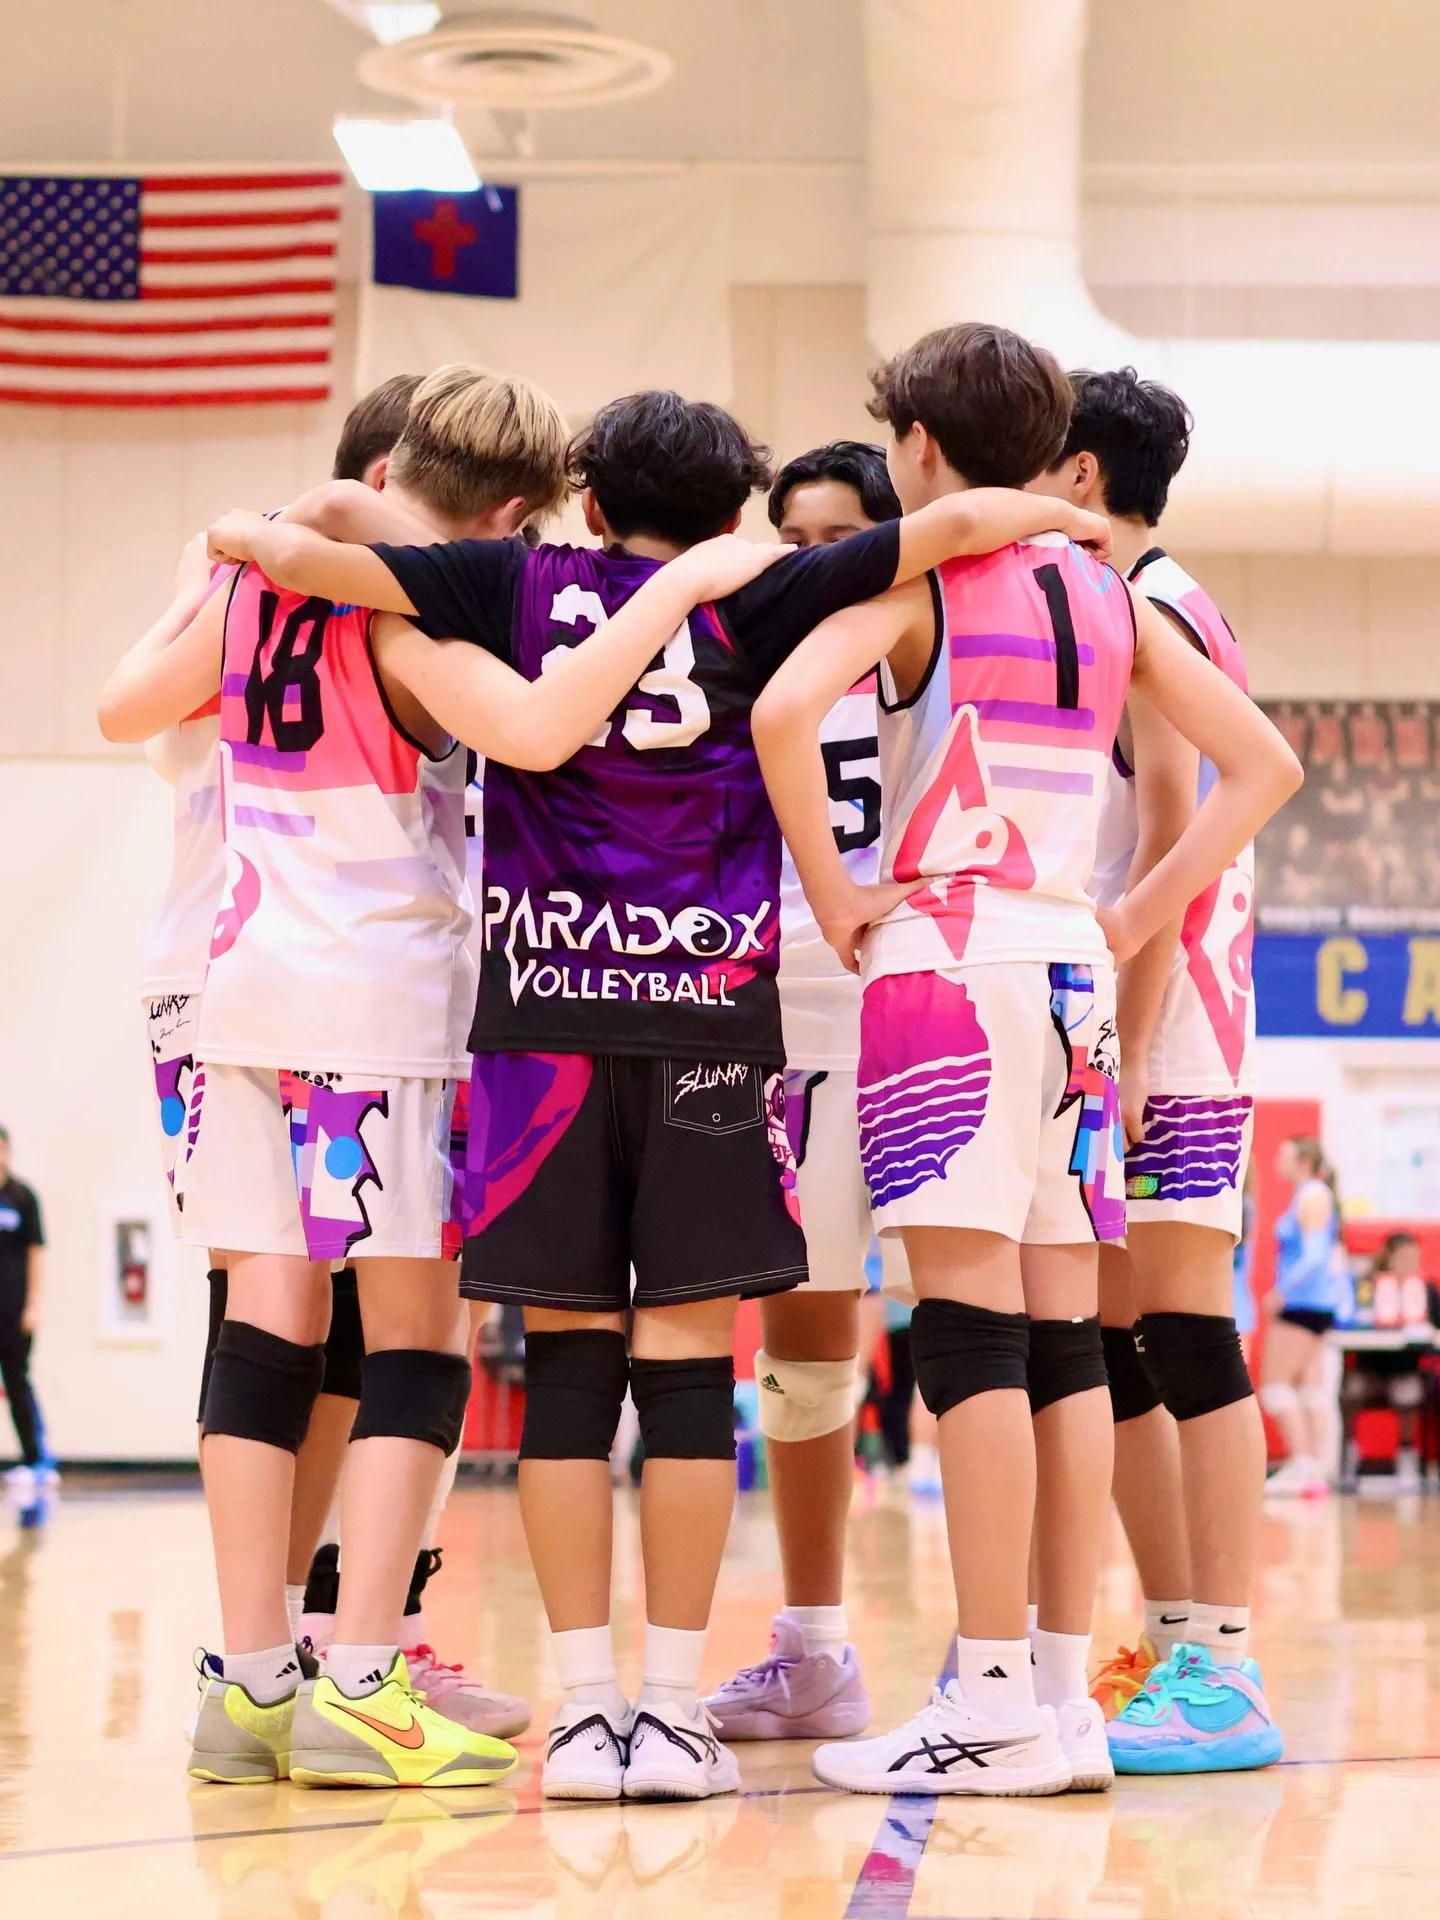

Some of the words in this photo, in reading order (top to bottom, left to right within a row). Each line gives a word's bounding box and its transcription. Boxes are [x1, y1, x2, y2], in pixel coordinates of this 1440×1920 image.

[244, 589, 325, 753] 18
[1032, 563, 1080, 711] 1
[820, 735, 882, 854] 5
[484, 885, 772, 960] PARADOX
[509, 956, 736, 1007] VOLLEYBALL
